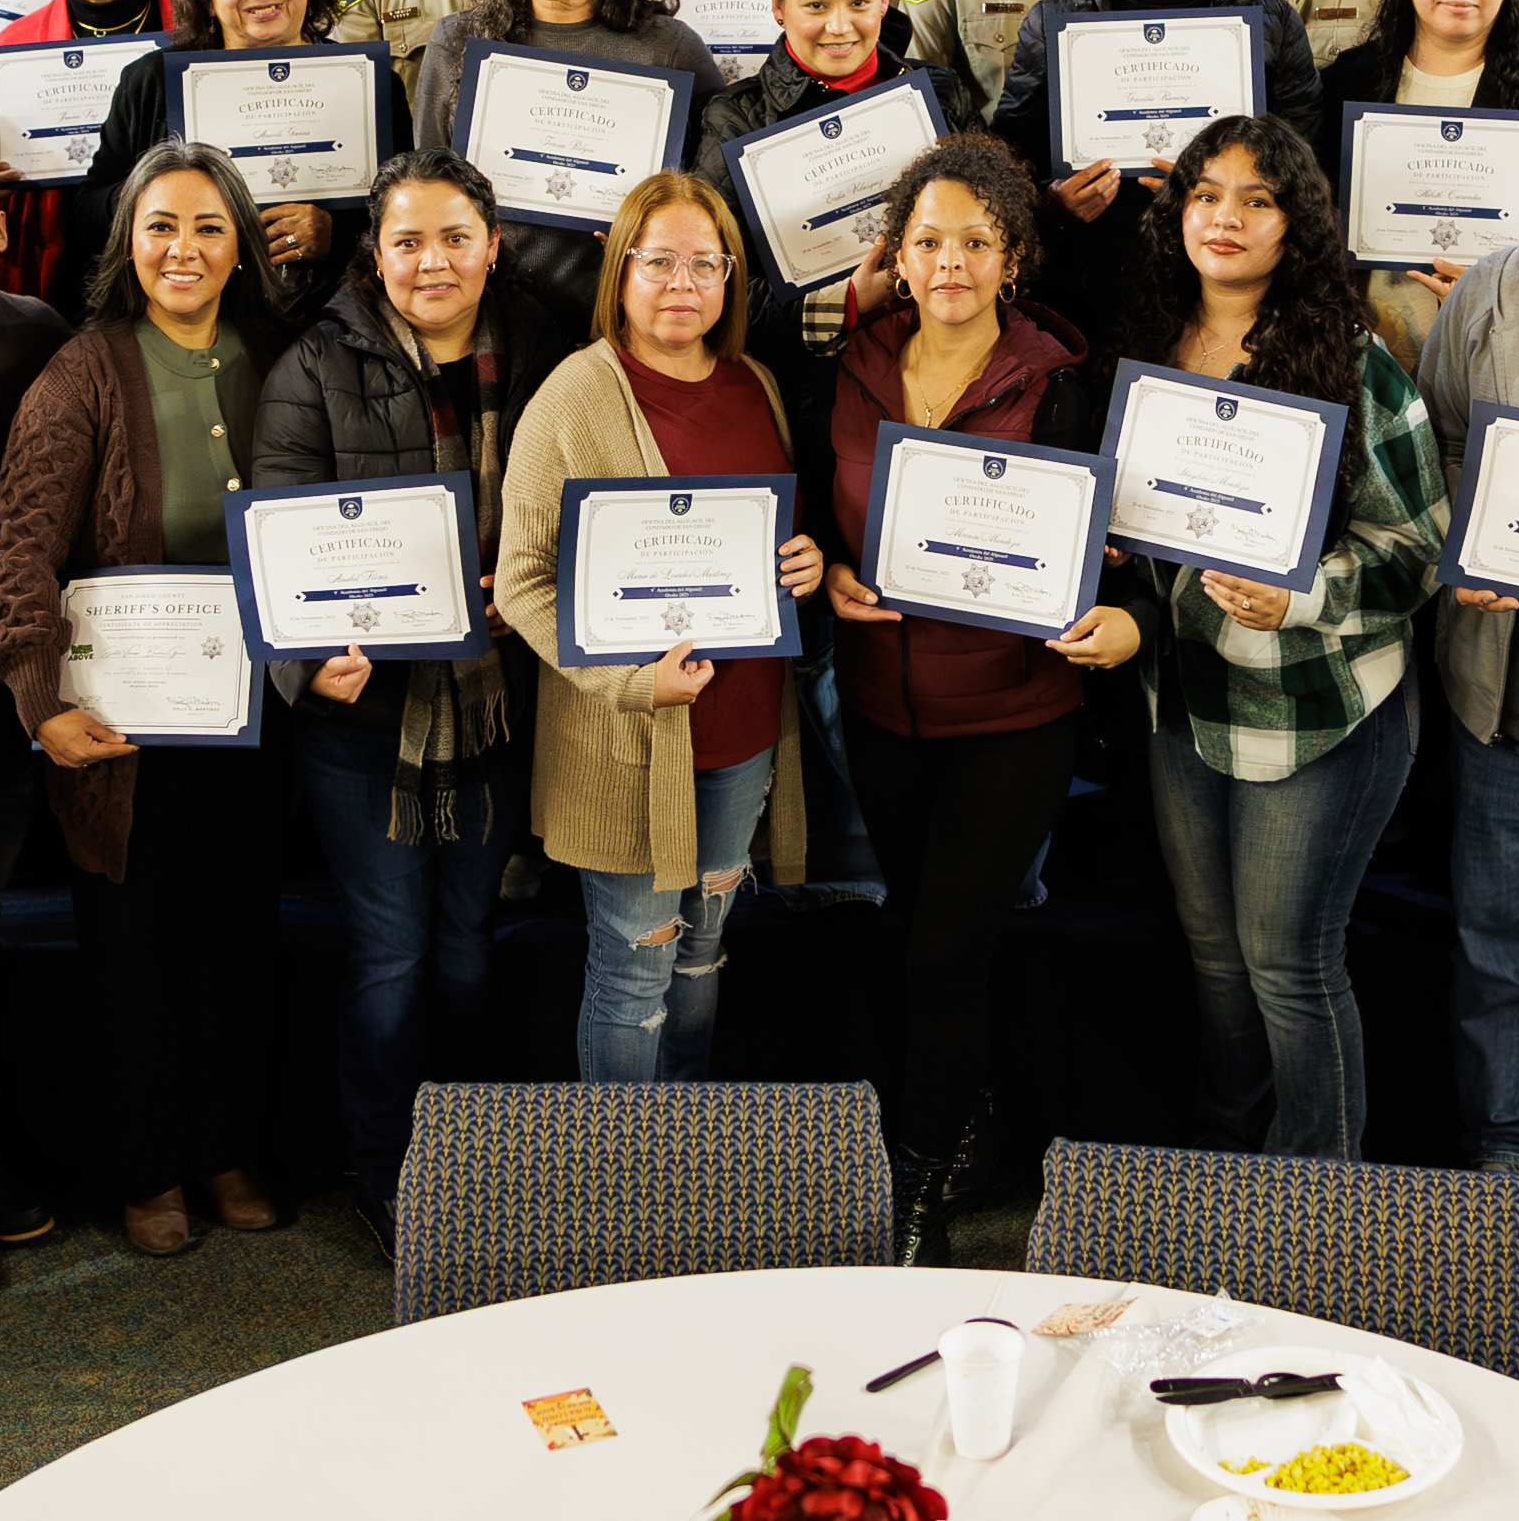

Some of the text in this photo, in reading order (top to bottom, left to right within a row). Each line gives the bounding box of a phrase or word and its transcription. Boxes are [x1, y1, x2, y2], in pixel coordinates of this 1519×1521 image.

[1114, 62, 1200, 76] CERTIFICADO
[239, 98, 324, 113] CERTIFICADO
[530, 106, 616, 129] CERTIFICADO
[804, 146, 886, 182] CERTIFICADO
[1407, 159, 1494, 175] CERTIFICADO
[1177, 435, 1264, 463] CERTIFICADO
[944, 496, 1035, 520] CERTIFICADO
[310, 538, 403, 556] CERTIFICADO
[634, 535, 722, 550] CERTIFICADO
[85, 604, 222, 616] SHERIFF'S OFFICE
